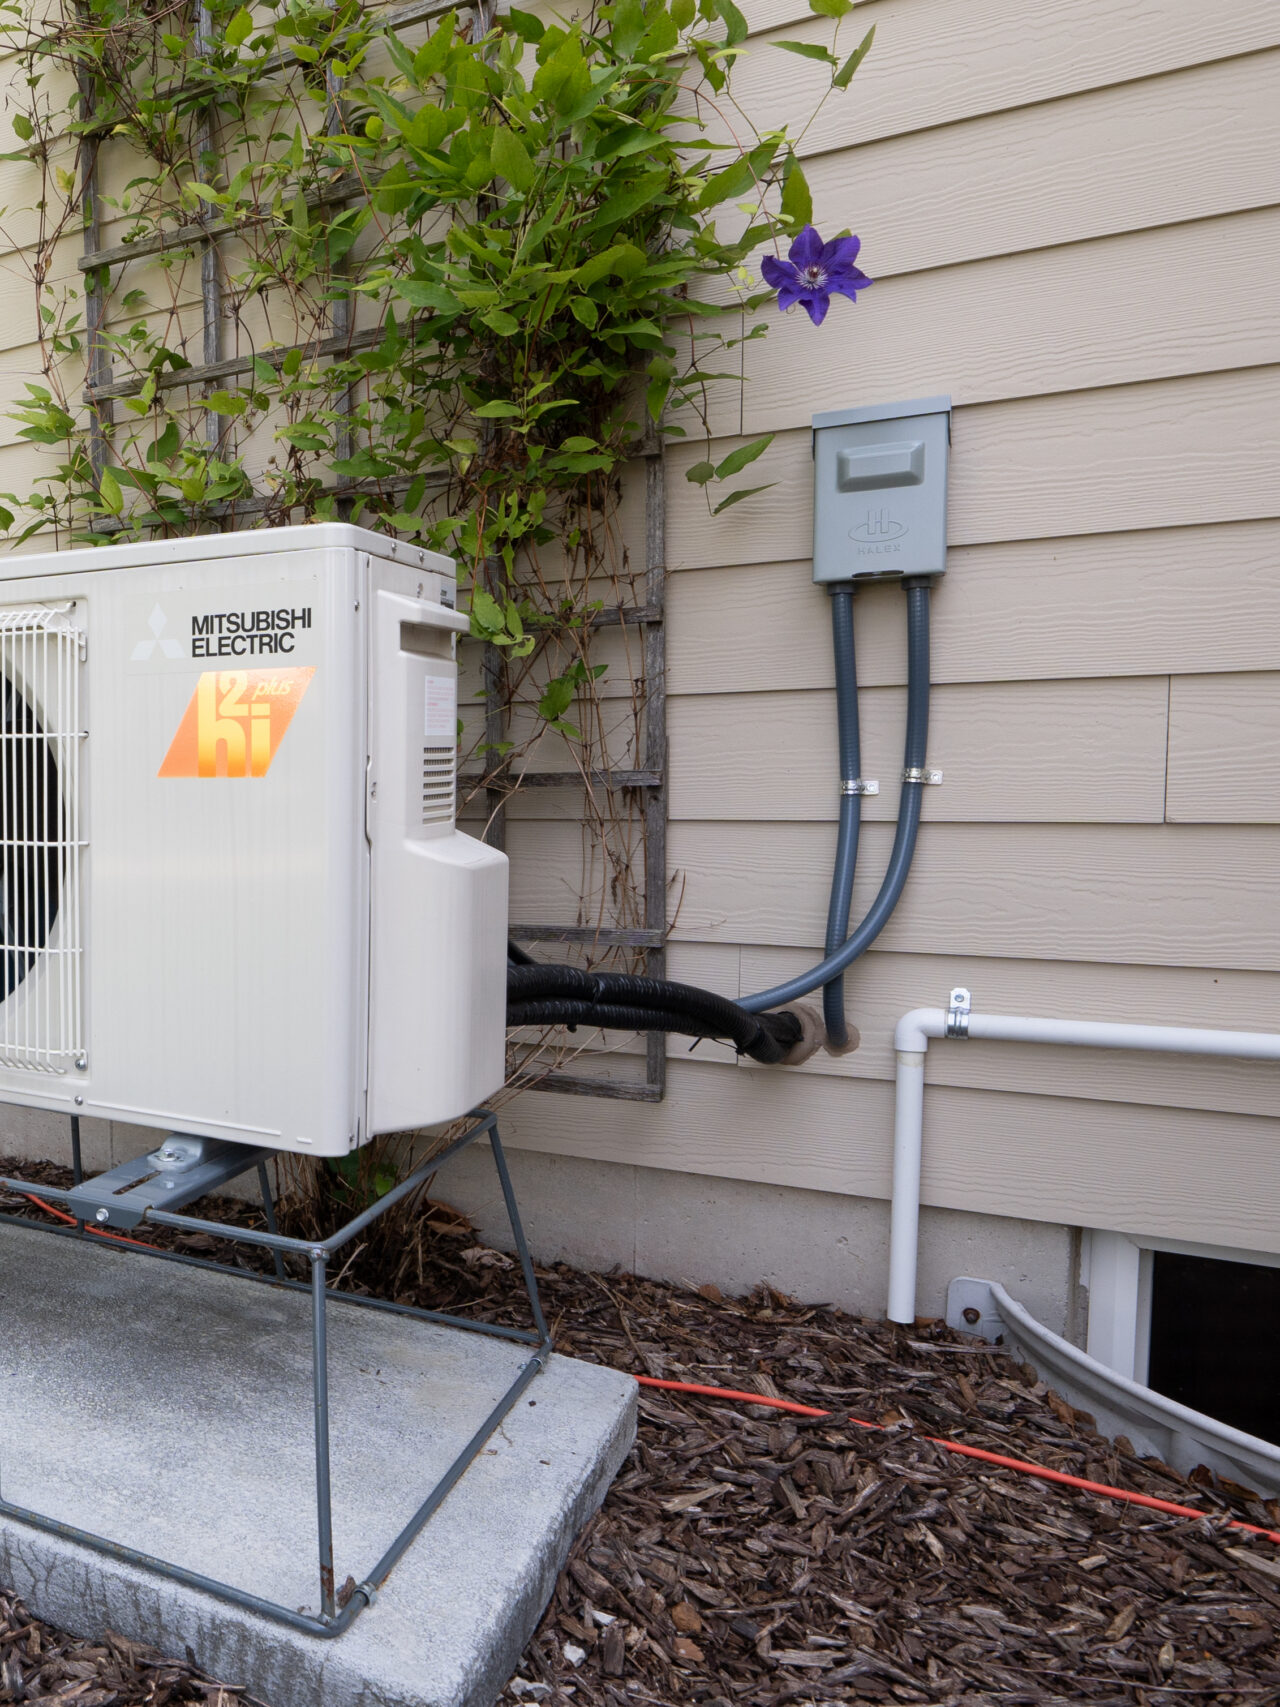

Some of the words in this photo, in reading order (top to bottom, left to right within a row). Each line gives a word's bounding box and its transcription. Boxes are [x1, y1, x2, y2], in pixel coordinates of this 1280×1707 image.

[857, 544, 901, 555] HALEX
[191, 607, 312, 635] MITSUBISHI
[191, 632, 295, 658] ELECTRIC
[252, 677, 293, 701] plus
